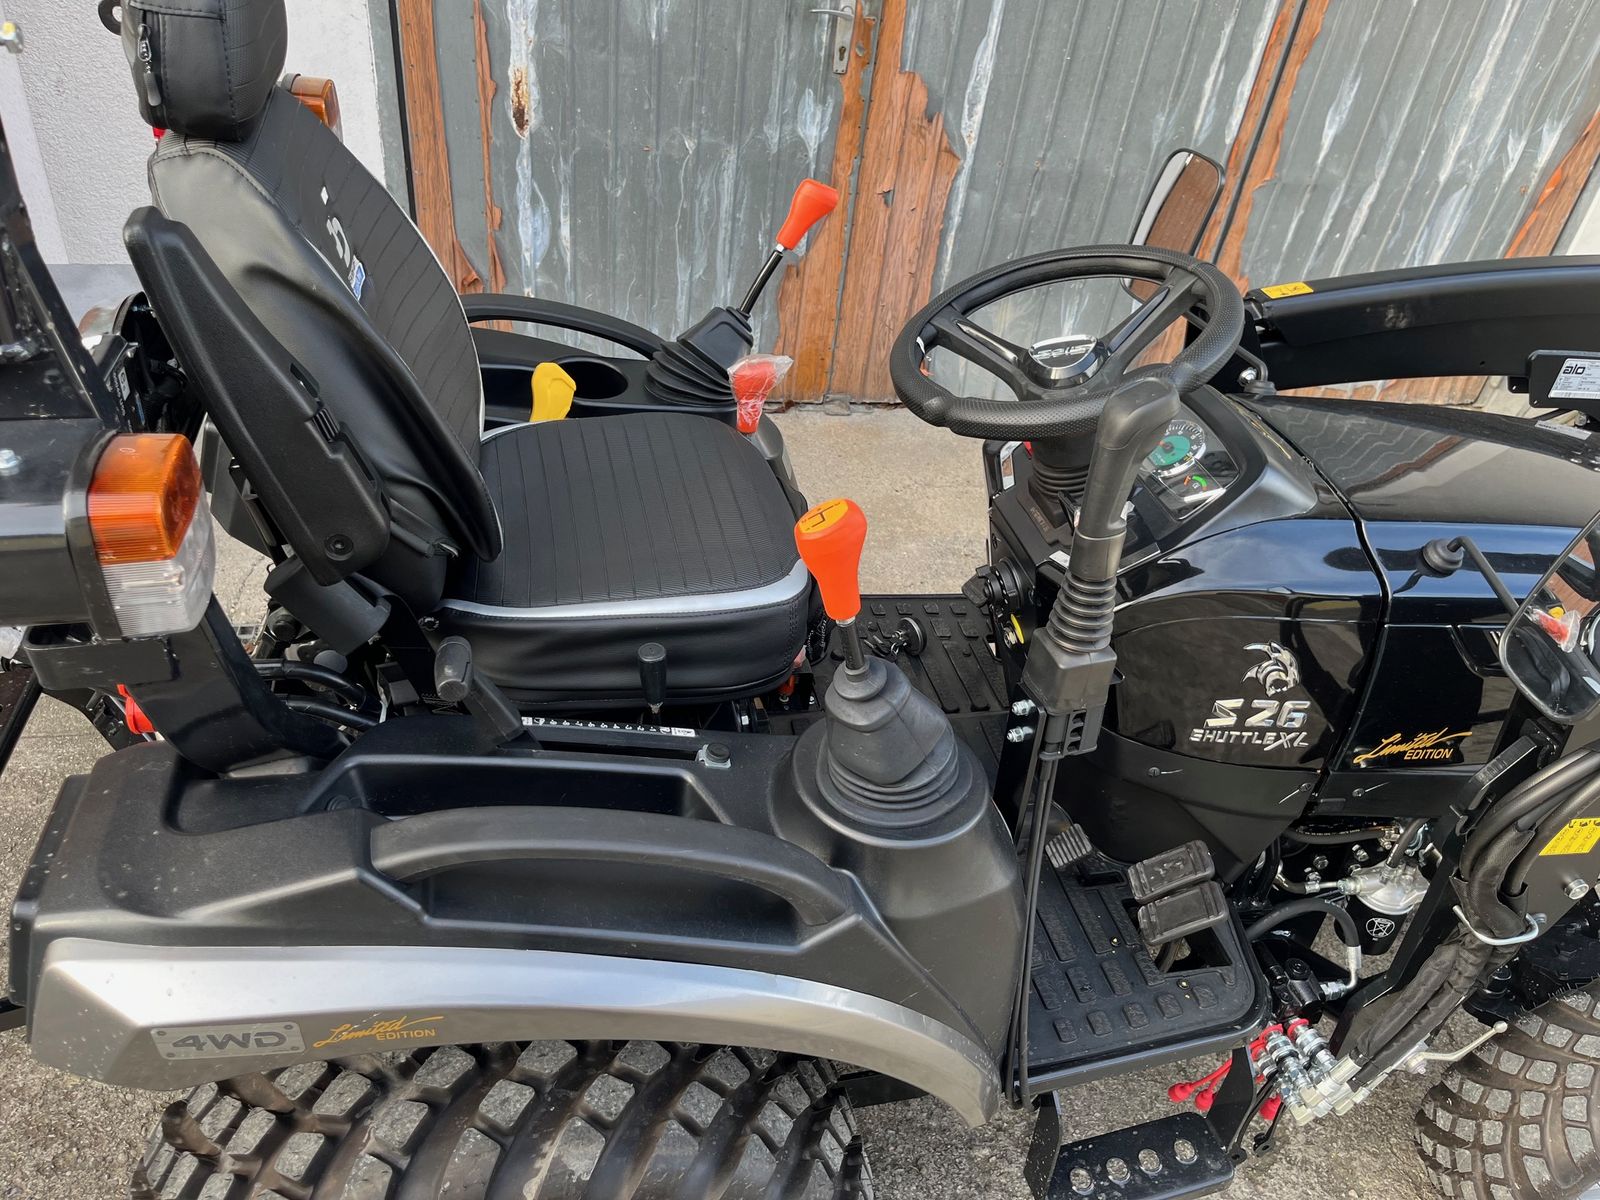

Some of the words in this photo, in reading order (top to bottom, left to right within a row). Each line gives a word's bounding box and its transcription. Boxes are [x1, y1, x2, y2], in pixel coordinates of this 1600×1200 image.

[1562, 363, 1586, 375] alo
[1244, 699, 1311, 729] 26
[1352, 727, 1473, 764] Limited
[1403, 748, 1454, 760] EDITION
[172, 1031, 288, 1051] 4WD
[313, 1015, 445, 1049] Limited
[376, 1027, 437, 1042] EDITION
